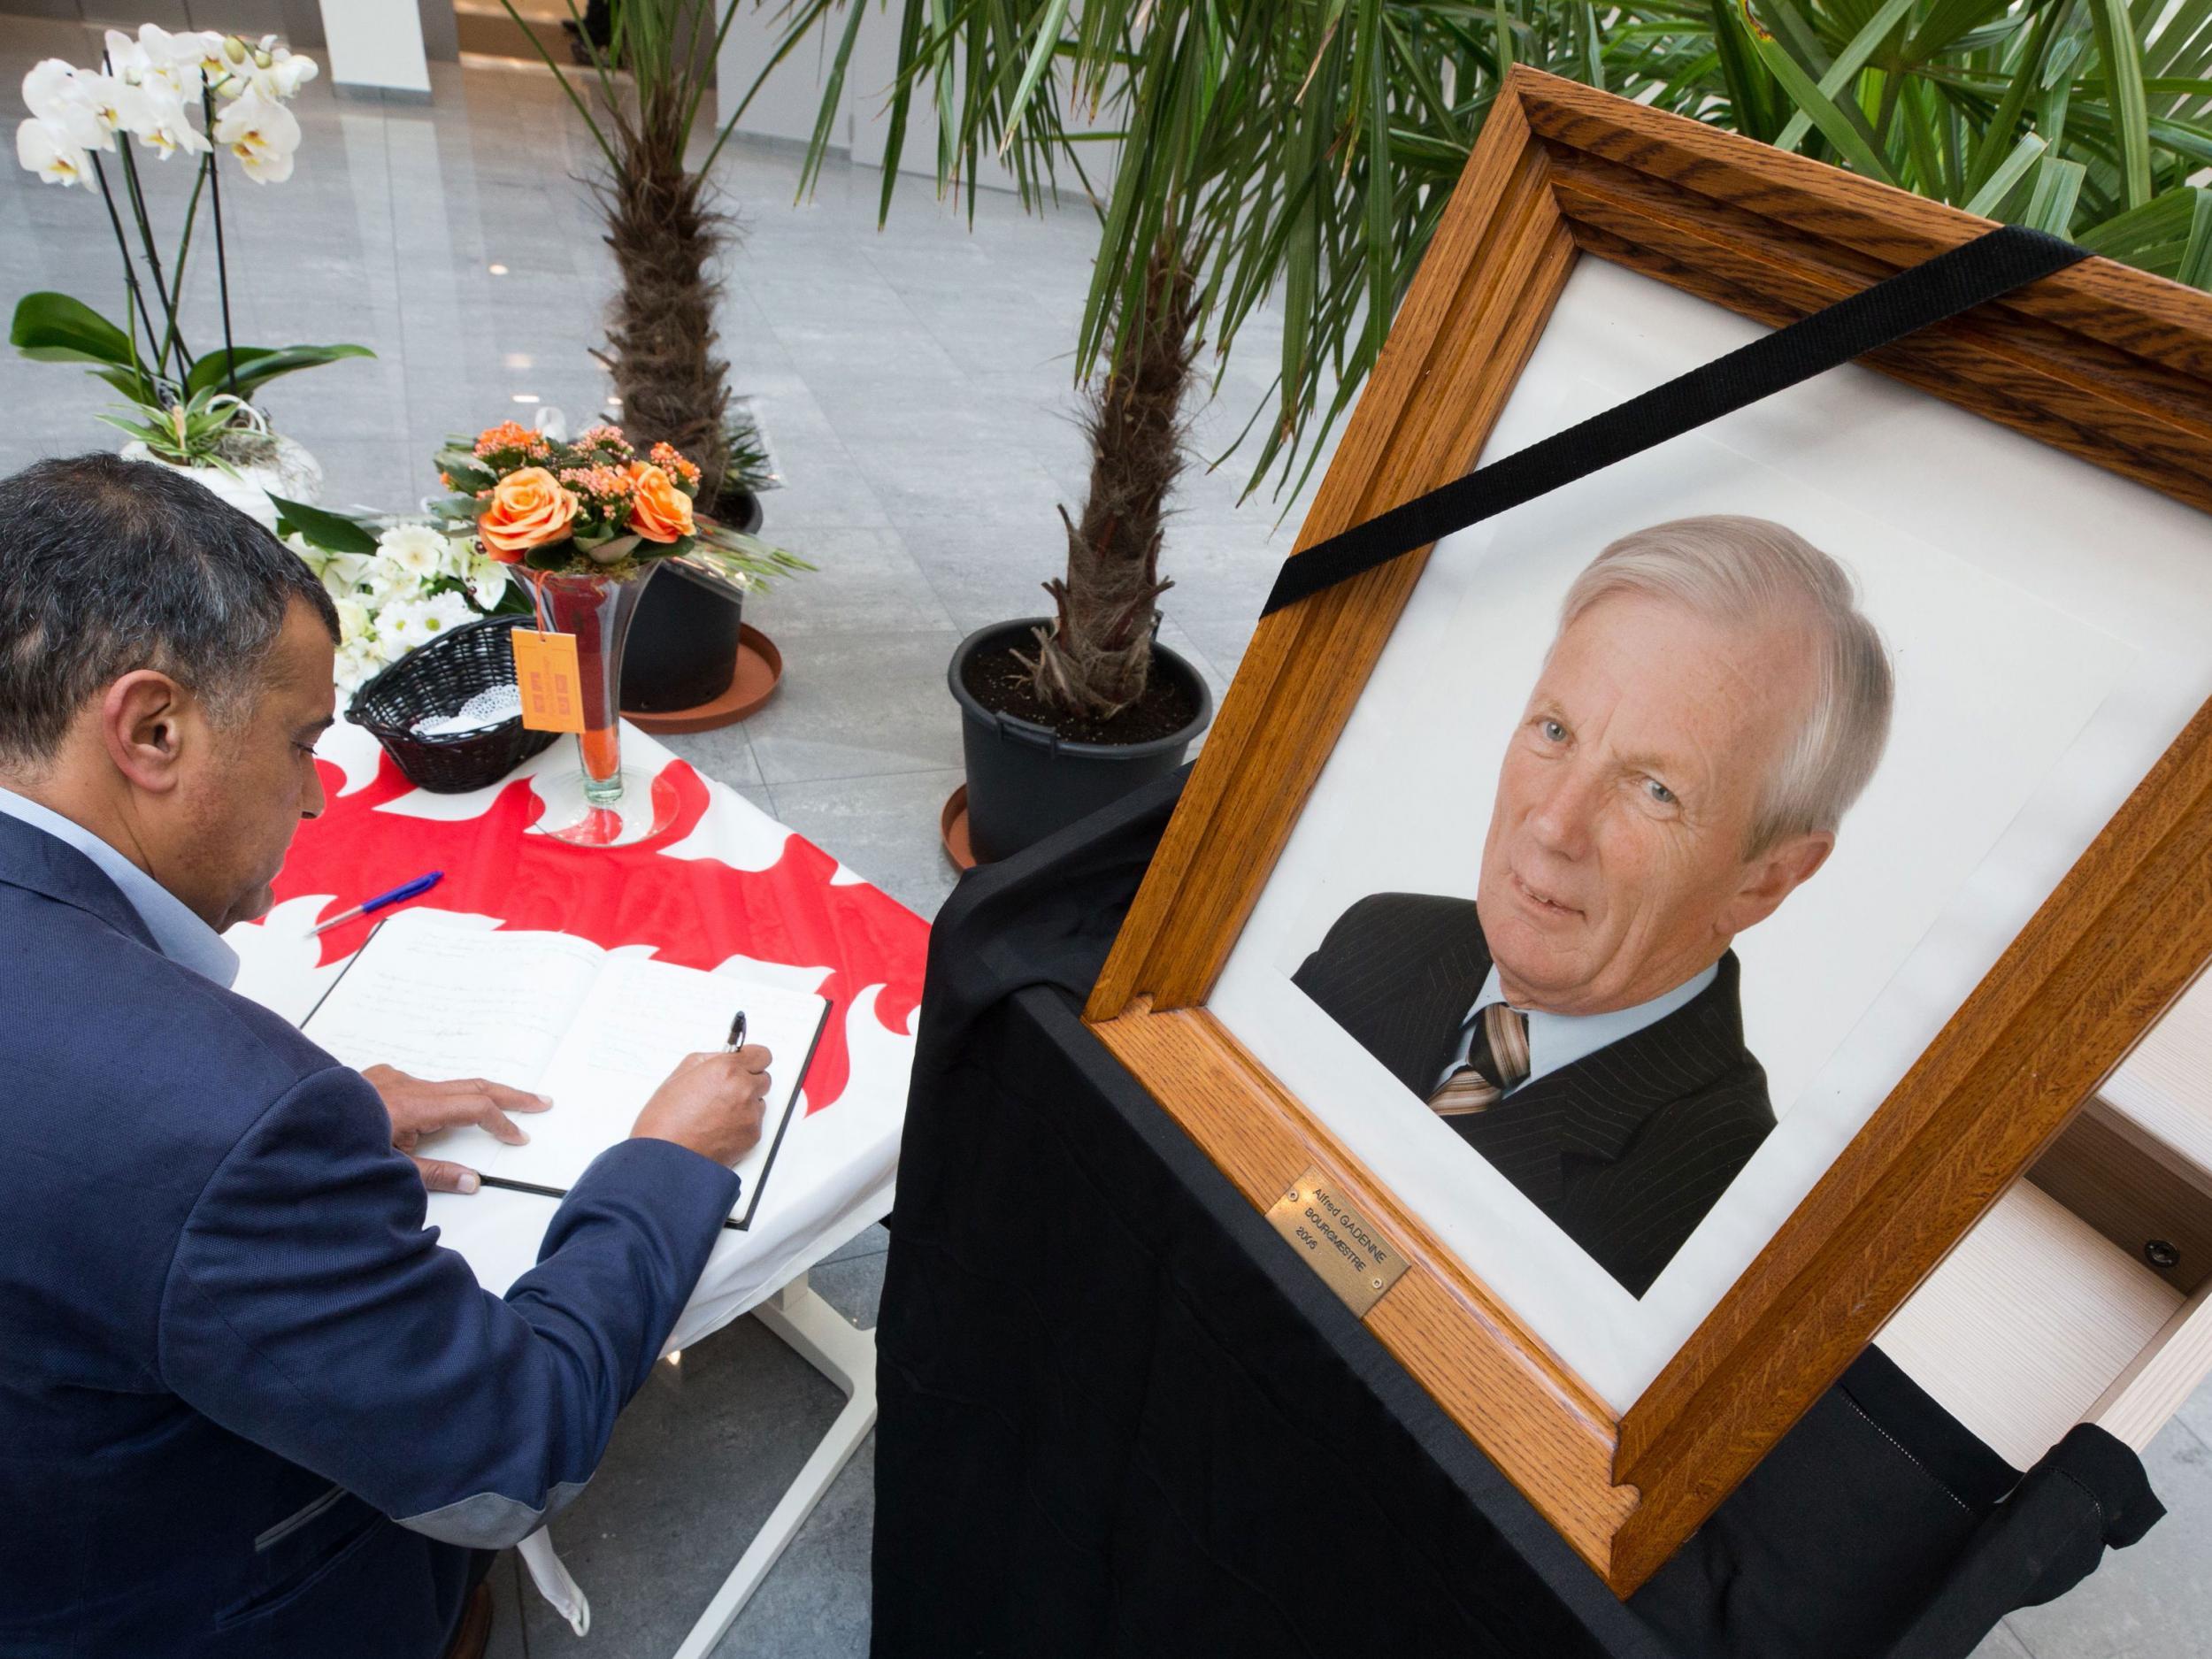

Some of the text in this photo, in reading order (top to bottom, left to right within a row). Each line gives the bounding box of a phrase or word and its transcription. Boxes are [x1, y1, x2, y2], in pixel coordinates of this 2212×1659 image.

[1304, 1207, 1366, 1272] BOURGMESTRE
[1312, 1188, 1386, 1264] Alfred GADENNE
